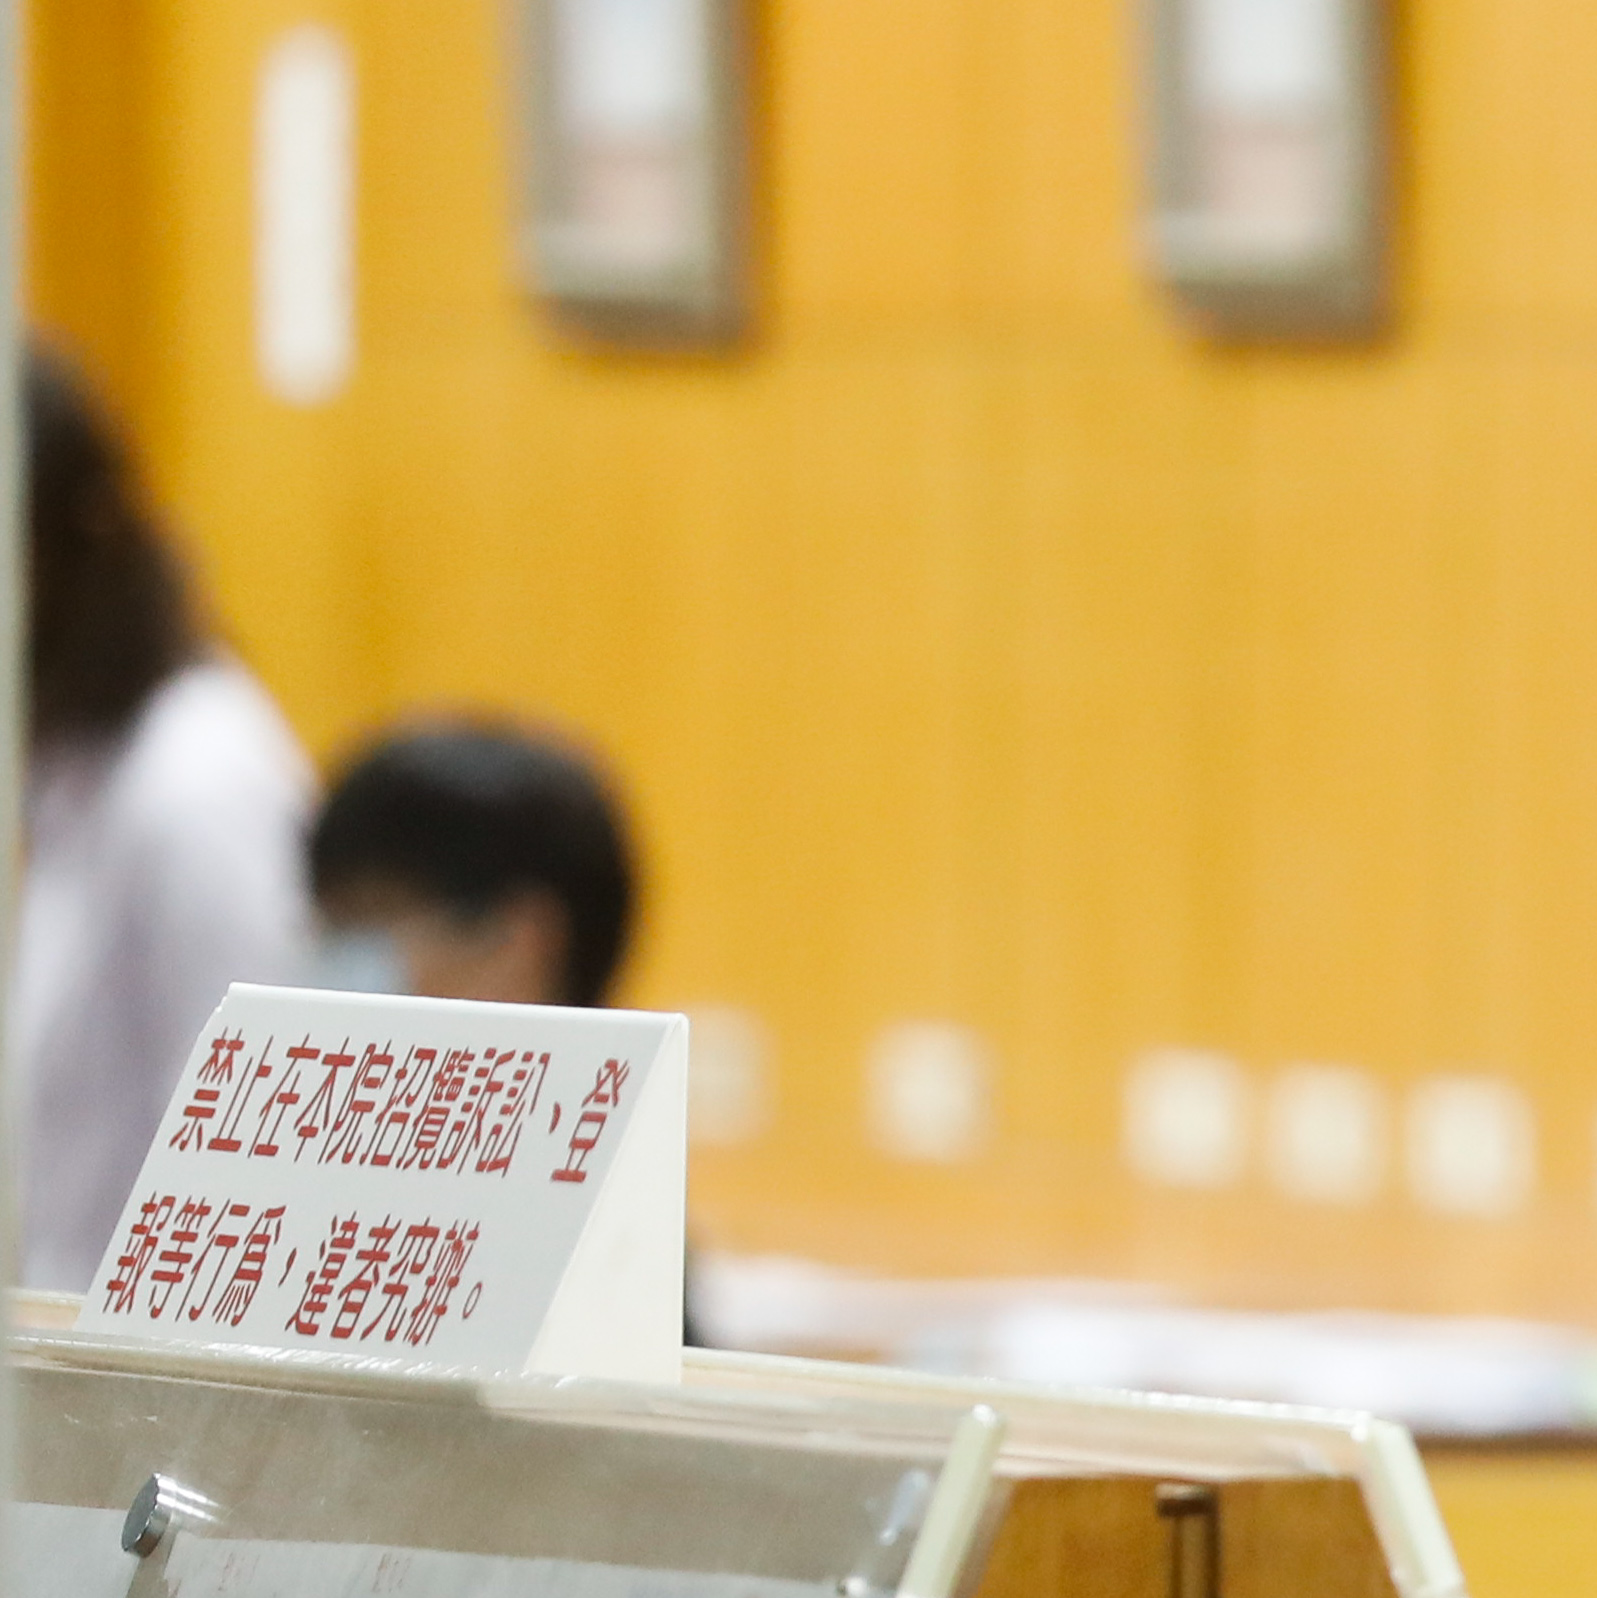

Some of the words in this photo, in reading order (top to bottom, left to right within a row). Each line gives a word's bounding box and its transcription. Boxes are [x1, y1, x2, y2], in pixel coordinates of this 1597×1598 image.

[169, 1026, 629, 1182] 禁止在本院招攬訴訟、登
